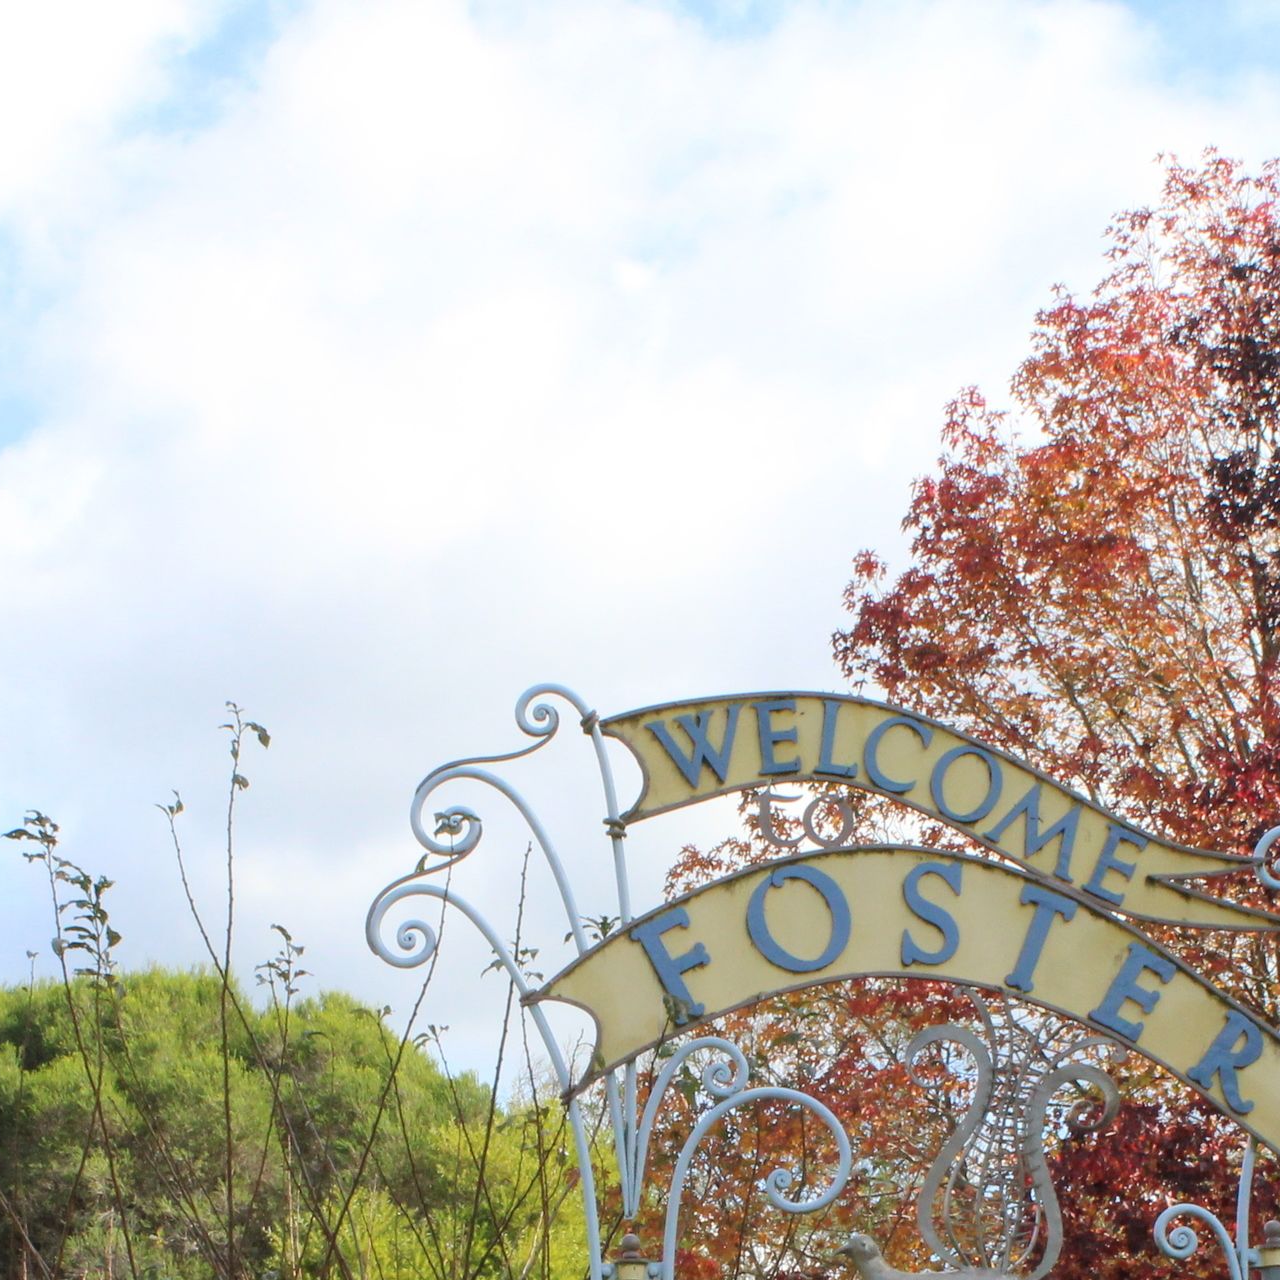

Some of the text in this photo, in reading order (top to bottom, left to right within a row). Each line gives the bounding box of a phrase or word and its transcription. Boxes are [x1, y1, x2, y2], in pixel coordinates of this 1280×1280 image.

[645, 698, 1150, 903] WELCOME
[754, 788, 854, 848] to
[630, 861, 1263, 1115] FOSTER
